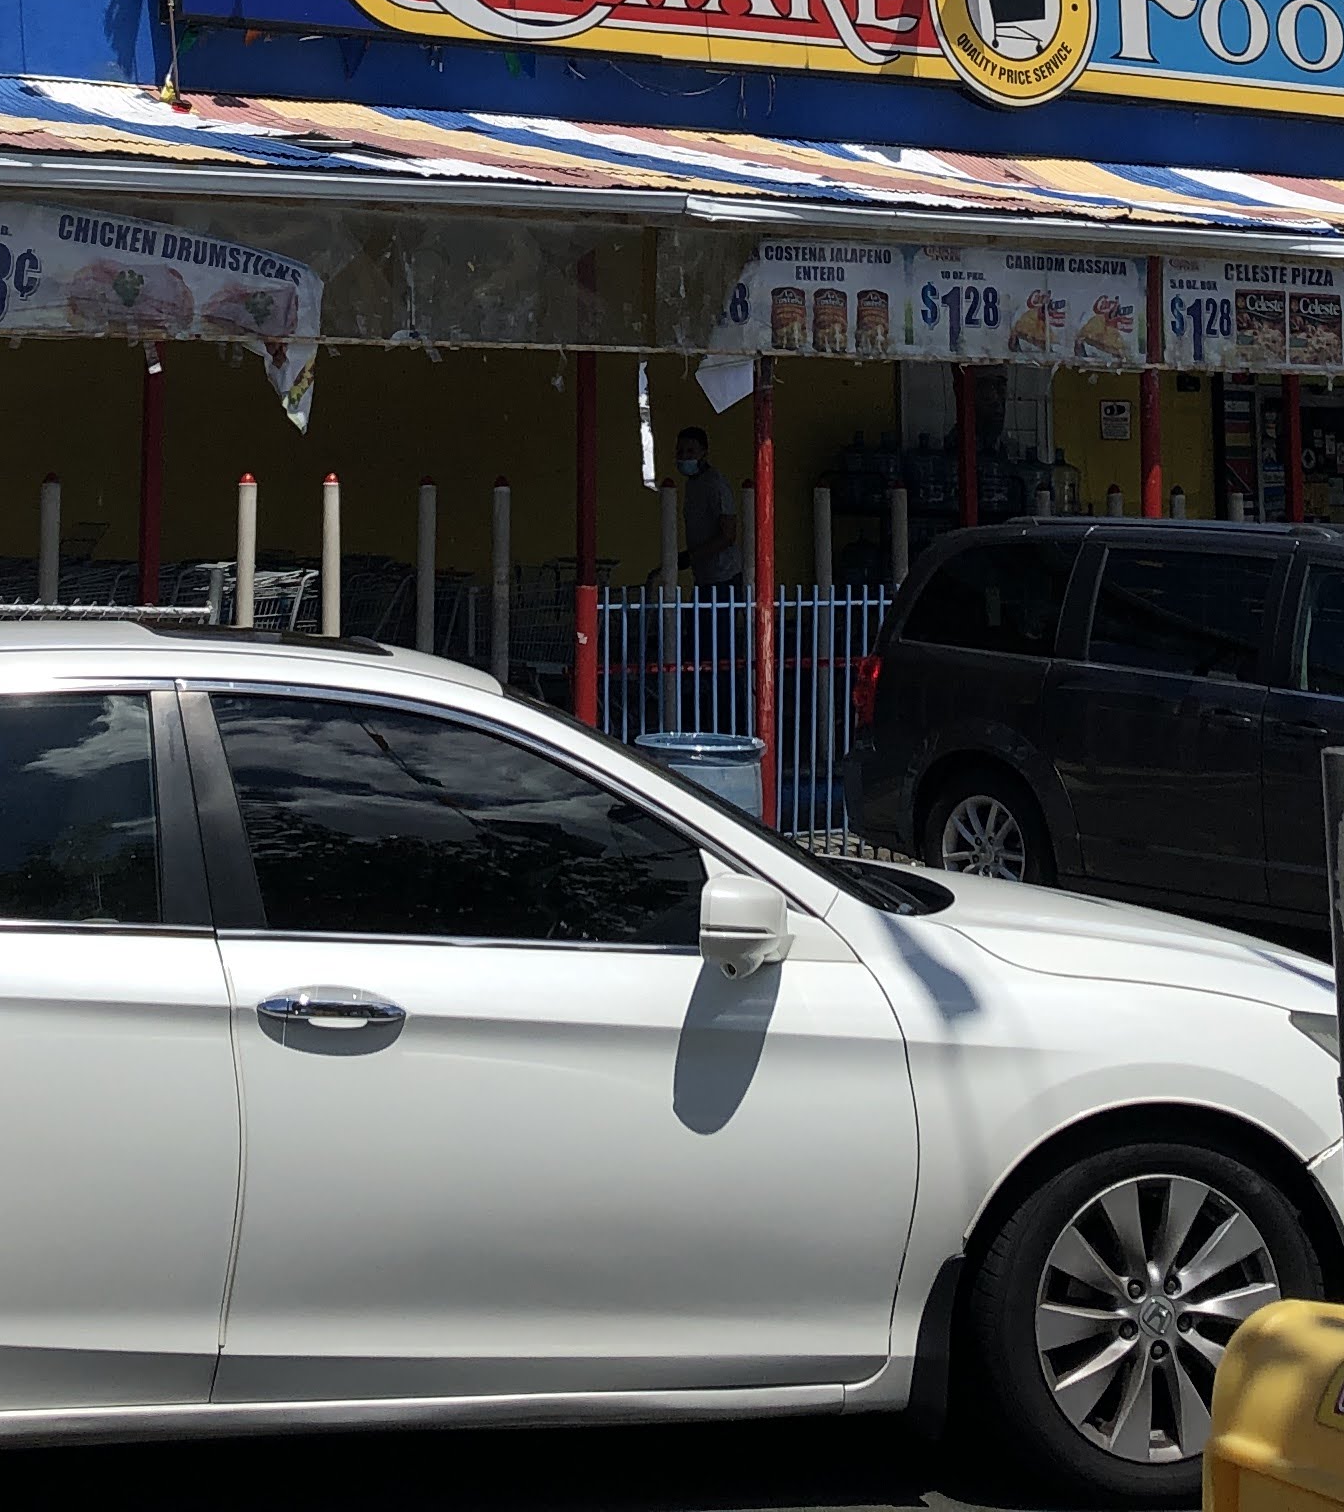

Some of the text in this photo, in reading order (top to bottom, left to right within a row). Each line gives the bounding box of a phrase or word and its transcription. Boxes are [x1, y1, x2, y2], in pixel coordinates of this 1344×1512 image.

[957, 33, 1072, 85] QUALITY PRICE SERVICE
[58, 214, 302, 286] CHICKEN DRUMSTICKS
[795, 266, 845, 282] ENTERO
[1006, 254, 1127, 276] CARIDOM CASSAVA
[1225, 263, 1334, 286] CELESTE PIZZA
[1246, 294, 1284, 313] Celeste
[1299, 297, 1340, 316] Celeste
[1170, 293, 1232, 361] $128
